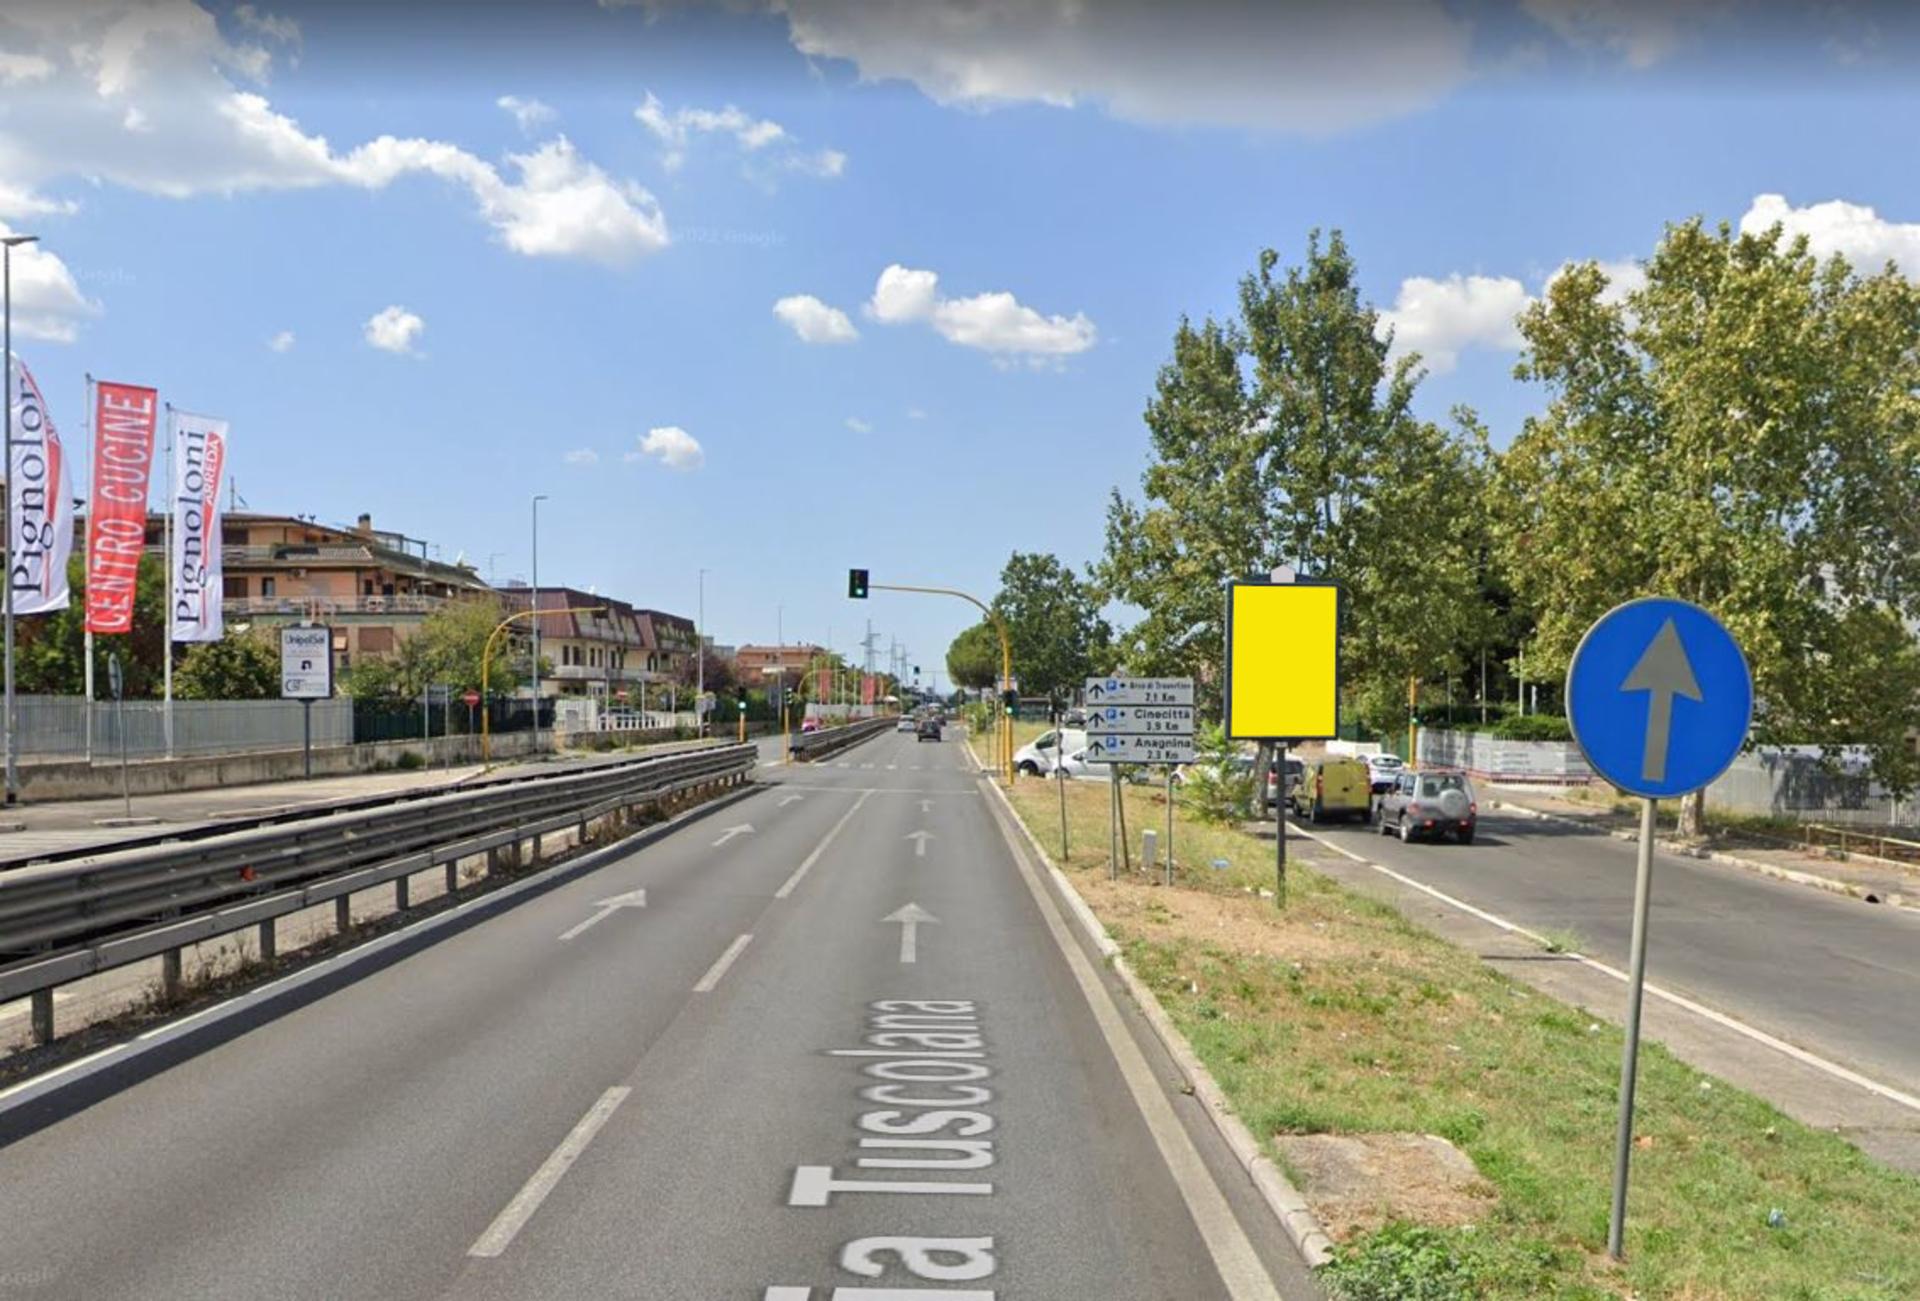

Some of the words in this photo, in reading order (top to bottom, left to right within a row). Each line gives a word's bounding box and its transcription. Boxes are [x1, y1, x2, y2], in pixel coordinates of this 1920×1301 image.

[11, 377, 54, 594] Pignolo
[102, 394, 151, 503] CUCINE
[89, 518, 144, 628] CENTRO
[176, 430, 207, 624] Pignoloni
[1134, 737, 1191, 749] Anagnina
[788, 1000, 995, 1206] Tuscolana
[763, 1236, 996, 1301] ia
